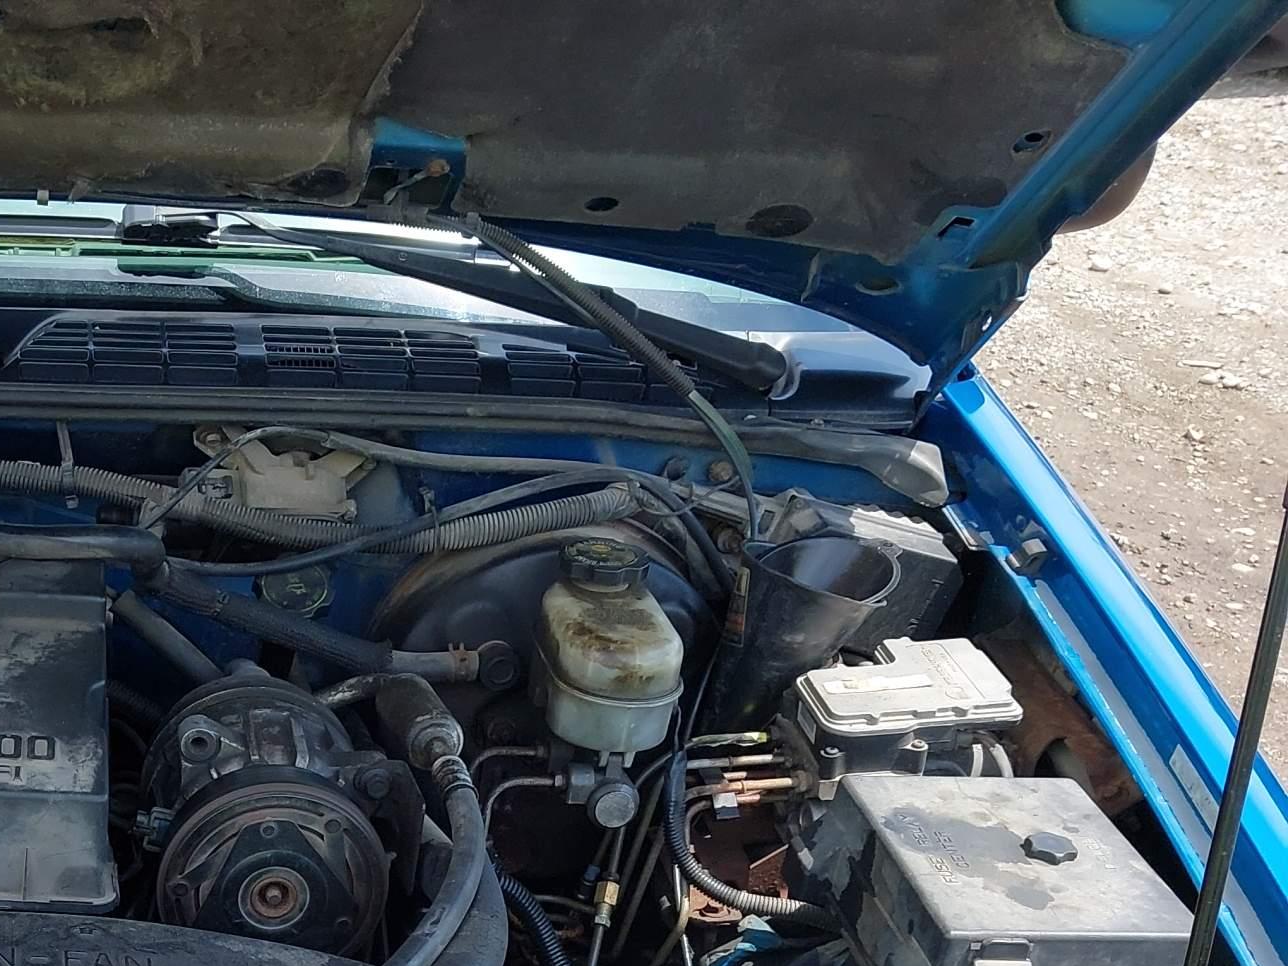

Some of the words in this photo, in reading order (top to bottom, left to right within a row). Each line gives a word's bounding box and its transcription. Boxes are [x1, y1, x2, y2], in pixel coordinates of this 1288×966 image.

[895, 812, 930, 847] RELAY
[933, 831, 970, 870] CENTER
[928, 855, 960, 886] FUSE
